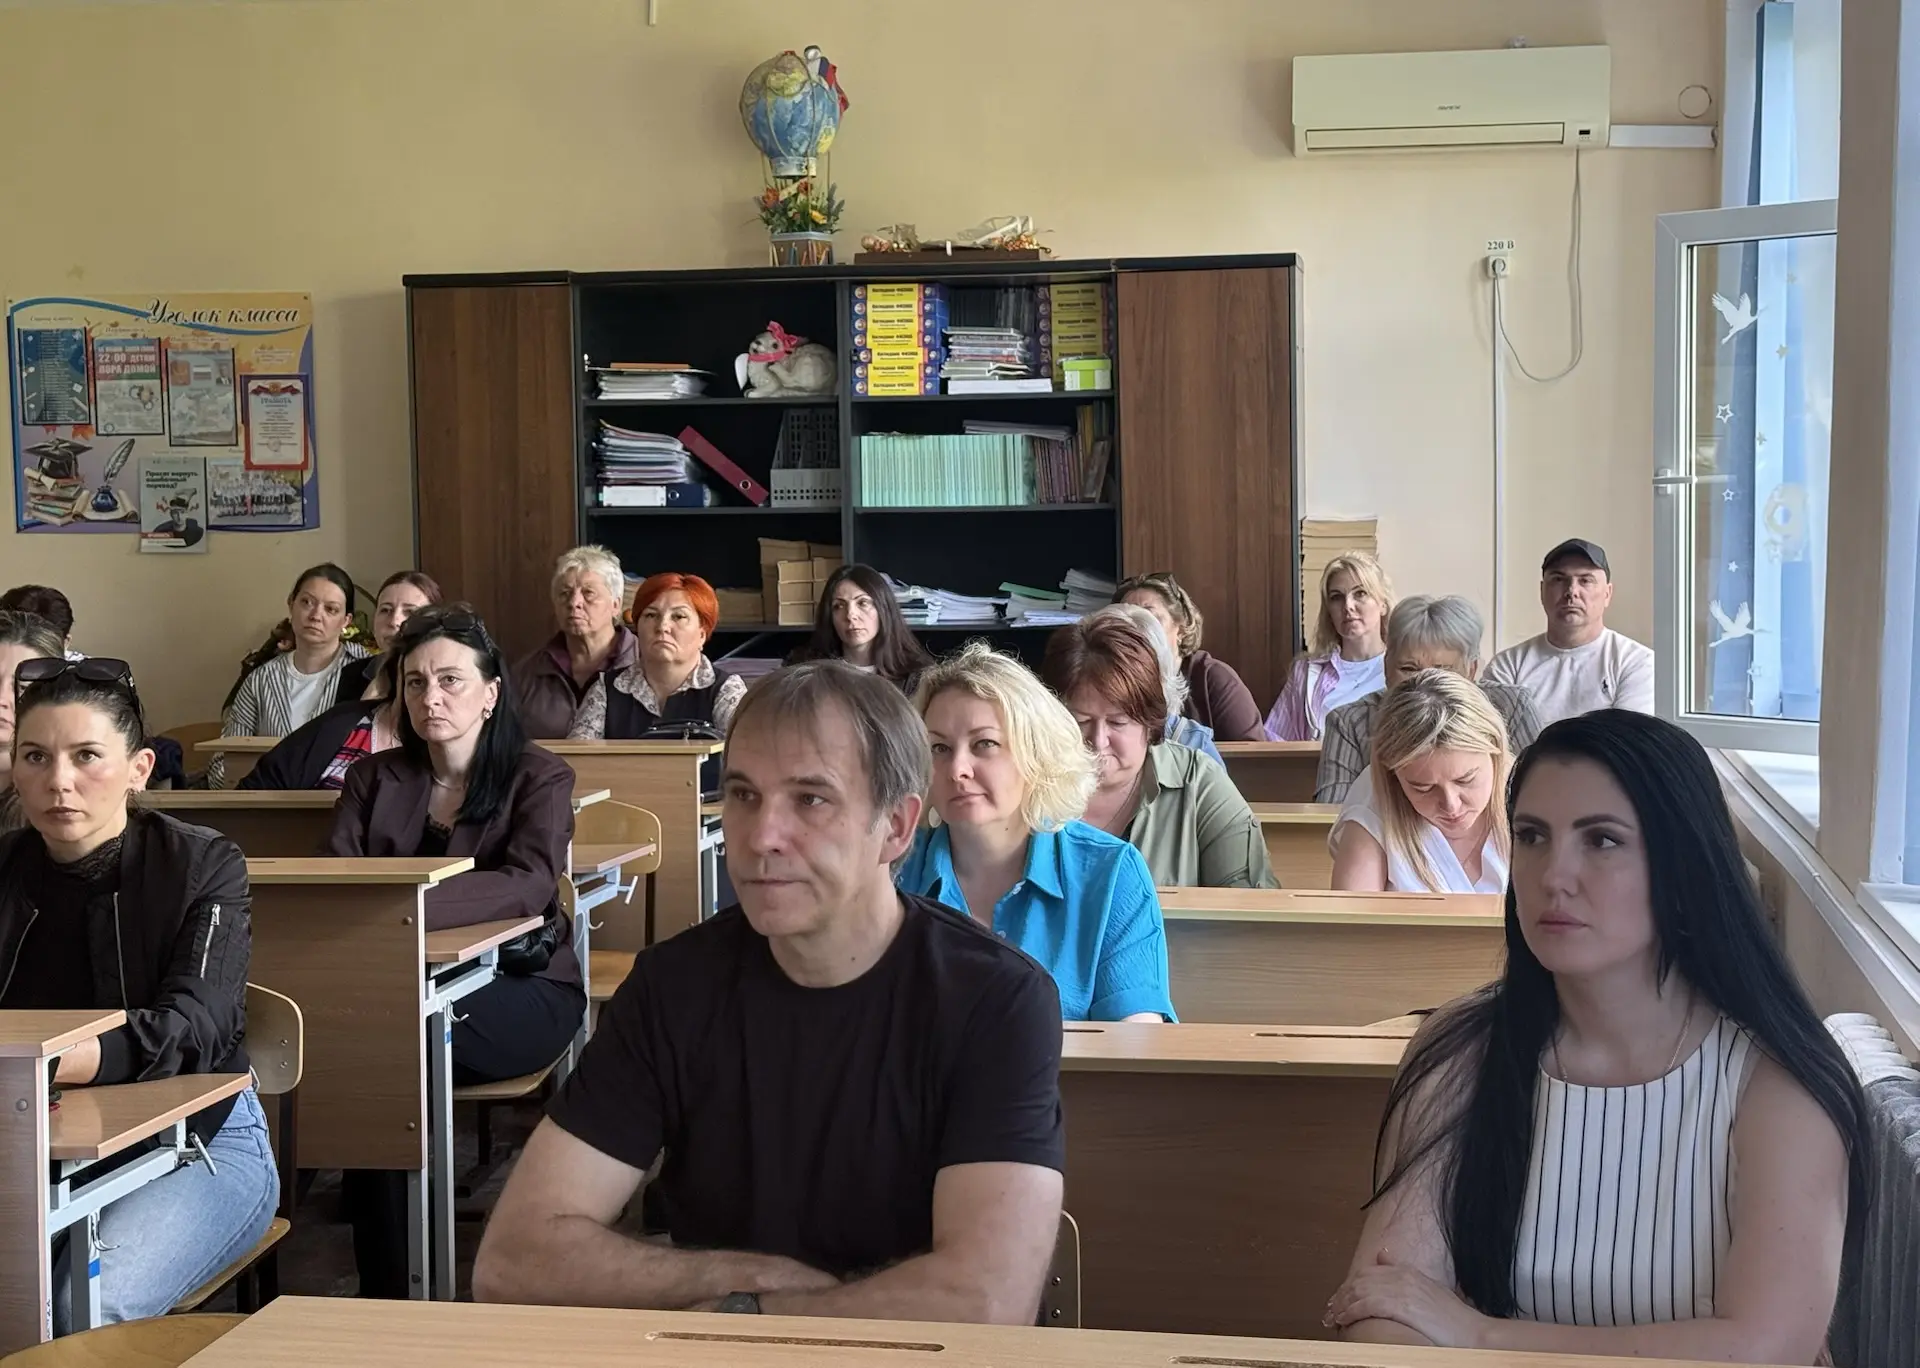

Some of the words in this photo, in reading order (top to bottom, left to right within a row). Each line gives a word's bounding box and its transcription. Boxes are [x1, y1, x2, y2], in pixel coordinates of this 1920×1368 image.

[1487, 241, 1504, 250] 220
[148, 299, 222, 324] Уголок
[227, 309, 299, 323] класса
[98, 365, 122, 374] ПОРА
[124, 363, 156, 374] ДОМОЙ
